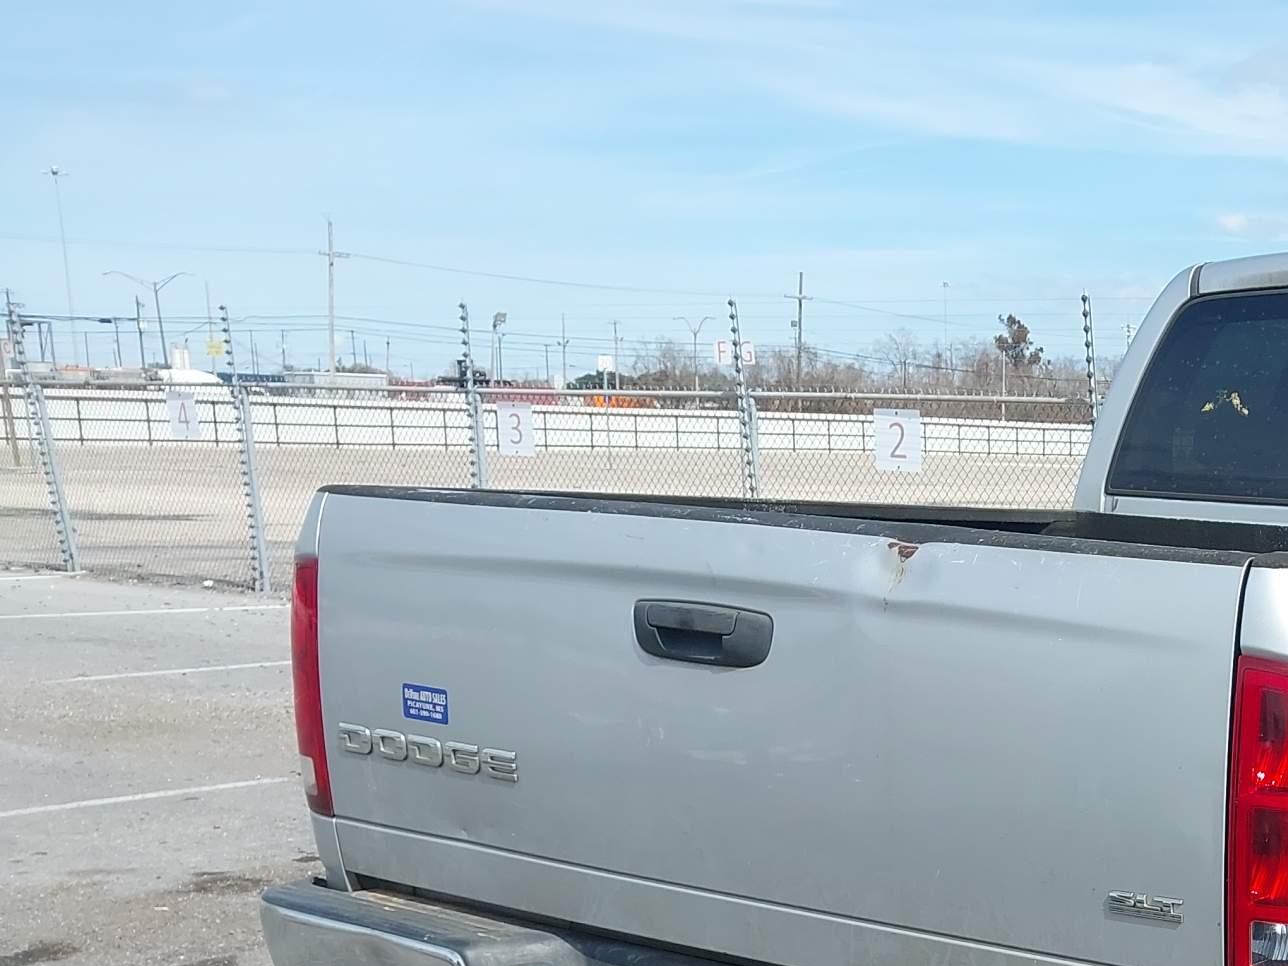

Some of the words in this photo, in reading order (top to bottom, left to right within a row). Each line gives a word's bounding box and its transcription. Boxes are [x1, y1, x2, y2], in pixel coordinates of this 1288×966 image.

[717, 340, 728, 363] F
[178, 401, 191, 431] 4
[508, 412, 523, 445] 3
[888, 421, 908, 459] 2
[338, 721, 519, 783] DODGE
[1107, 890, 1184, 920] SLT
